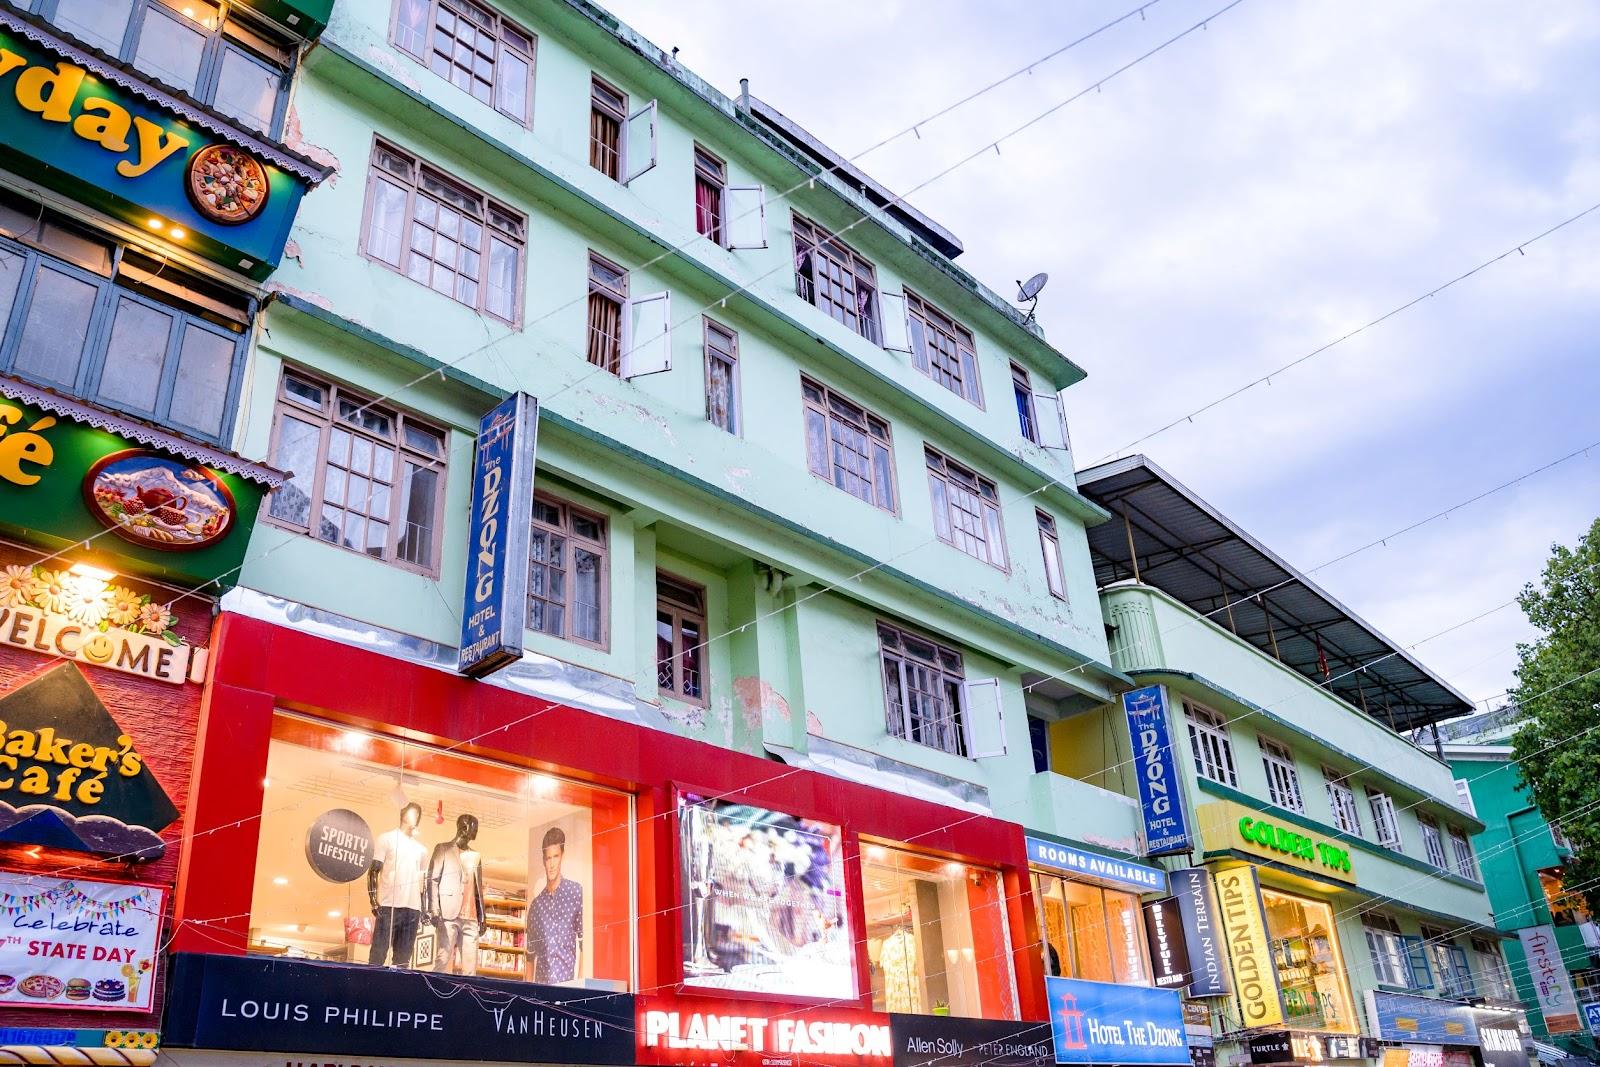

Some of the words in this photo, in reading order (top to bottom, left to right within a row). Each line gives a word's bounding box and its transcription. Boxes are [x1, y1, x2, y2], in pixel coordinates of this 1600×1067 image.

[474, 466, 502, 603] DZONG
[468, 605, 496, 630] HOTEL
[478, 624, 485, 637] &
[460, 630, 500, 663] RESTAURANT
[1137, 723, 1155, 731] The
[0, 717, 142, 778] aker's
[1139, 729, 1171, 815] DZONG
[1149, 817, 1177, 830] HOTEL
[1162, 828, 1169, 836] &
[320, 825, 369, 854] SPORTY
[1147, 833, 1187, 850] RESTAURANT
[318, 841, 366, 868] LIFESTYLE
[1038, 845, 1087, 869] ROOMS
[1090, 858, 1157, 885] AVAILABLE
[1316, 841, 1352, 873] TIPS
[1188, 873, 1210, 934] TERRAIN
[1220, 875, 1247, 923] TIPS
[13, 912, 140, 937] Celebrate
[27, 941, 87, 960] STATE
[92, 946, 137, 964] DAY
[1201, 937, 1221, 990] INDIAN
[1230, 923, 1267, 1020] GOLDEN
[1528, 932, 1562, 1008] firstcry
[221, 999, 310, 1023] LOUIS
[323, 1006, 444, 1032] PHILIPPE
[645, 1010, 768, 1051] PLANET
[777, 1019, 892, 1057] FASHION
[907, 1037, 936, 1054] Allen
[936, 1038, 964, 1058] Solly
[1251, 1043, 1280, 1053] TURTLE
[1480, 1027, 1522, 1052] SAMSUNG
[979, 1043, 1003, 1056] PETER
[1005, 1044, 1048, 1057] ENGLAND
